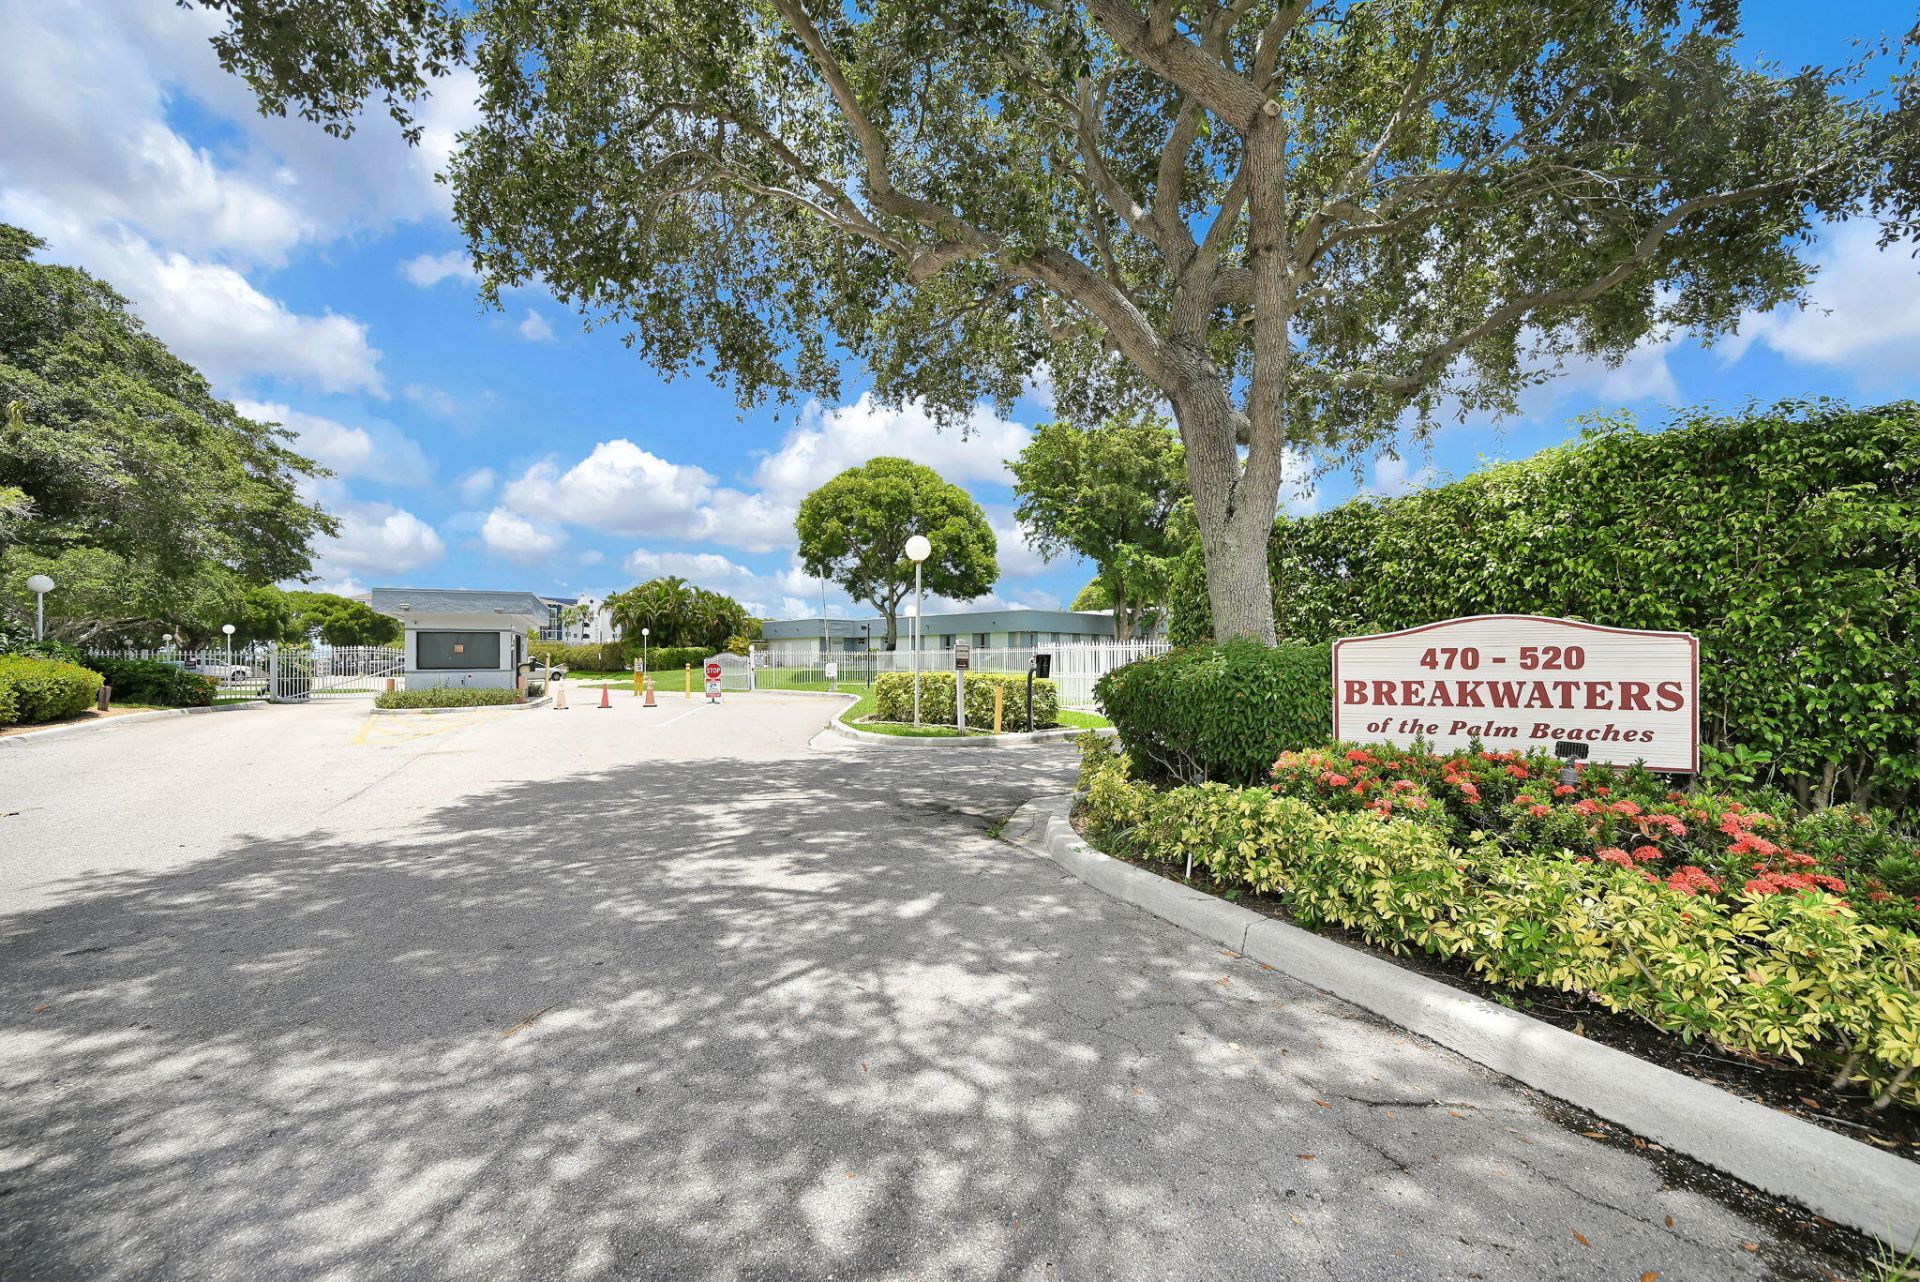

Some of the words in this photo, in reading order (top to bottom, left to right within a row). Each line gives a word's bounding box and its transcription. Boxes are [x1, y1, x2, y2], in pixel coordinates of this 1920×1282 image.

[1420, 647, 1480, 671] 470
[1519, 646, 1585, 670] 520
[1344, 680, 1685, 712] BREAKWATERS
[1367, 717, 1393, 734] of
[1399, 719, 1439, 735] the
[1448, 720, 1518, 738] Palm
[1529, 722, 1655, 743] Beaches
